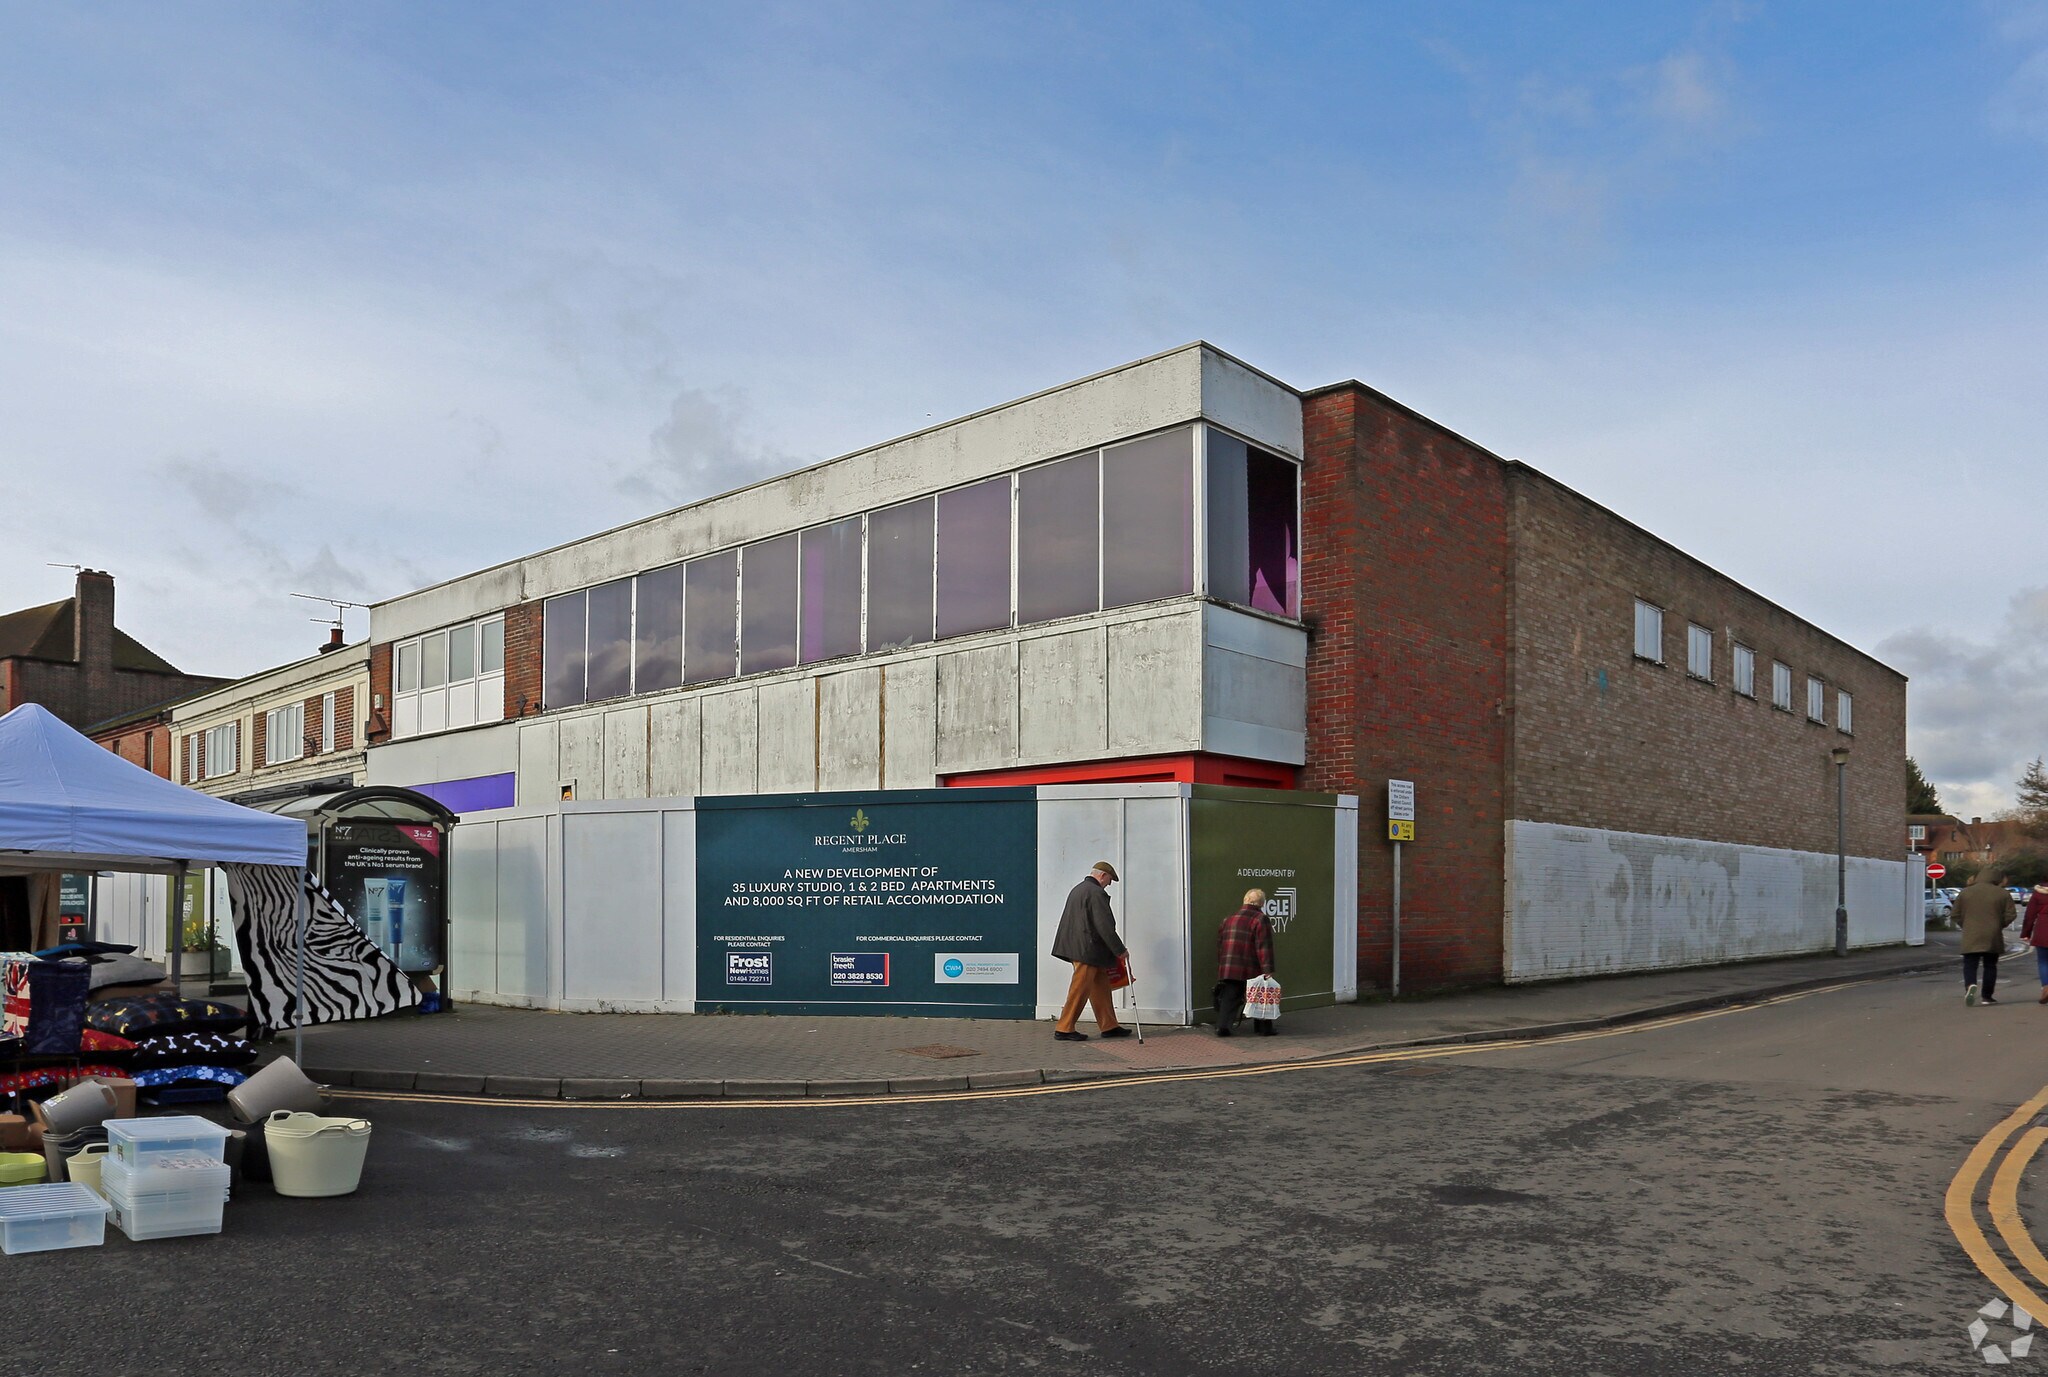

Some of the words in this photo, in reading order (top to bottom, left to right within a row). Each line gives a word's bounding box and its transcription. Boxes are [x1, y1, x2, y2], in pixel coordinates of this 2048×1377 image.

[815, 835, 864, 846] REGENT
[867, 834, 907, 845] PLACE
[360, 847, 387, 855] Clinically
[783, 869, 792, 879] A
[795, 869, 824, 879] NEW
[827, 867, 918, 879] DEVELOPMENT
[920, 866, 938, 877] OF
[1242, 869, 1286, 877] DEVELOPMENT
[1287, 869, 1295, 877] BY
[732, 883, 746, 893] 35
[749, 882, 794, 893] LUXURY
[797, 882, 845, 893] STUDIO,
[849, 882, 855, 891] 1
[858, 882, 867, 891] &
[870, 882, 878, 891] 2
[881, 881, 905, 891] BED
[911, 880, 995, 891] APARTMENTS
[724, 896, 750, 906] AND
[752, 896, 784, 907] 8,000
[787, 896, 803, 907] SQ
[806, 896, 820, 906] FT
[823, 896, 840, 906] OF
[843, 895, 883, 906] RETAIL
[886, 894, 1004, 905] ACCOMMODATION
[729, 955, 769, 967] Frost
[833, 955, 855, 963] brasier
